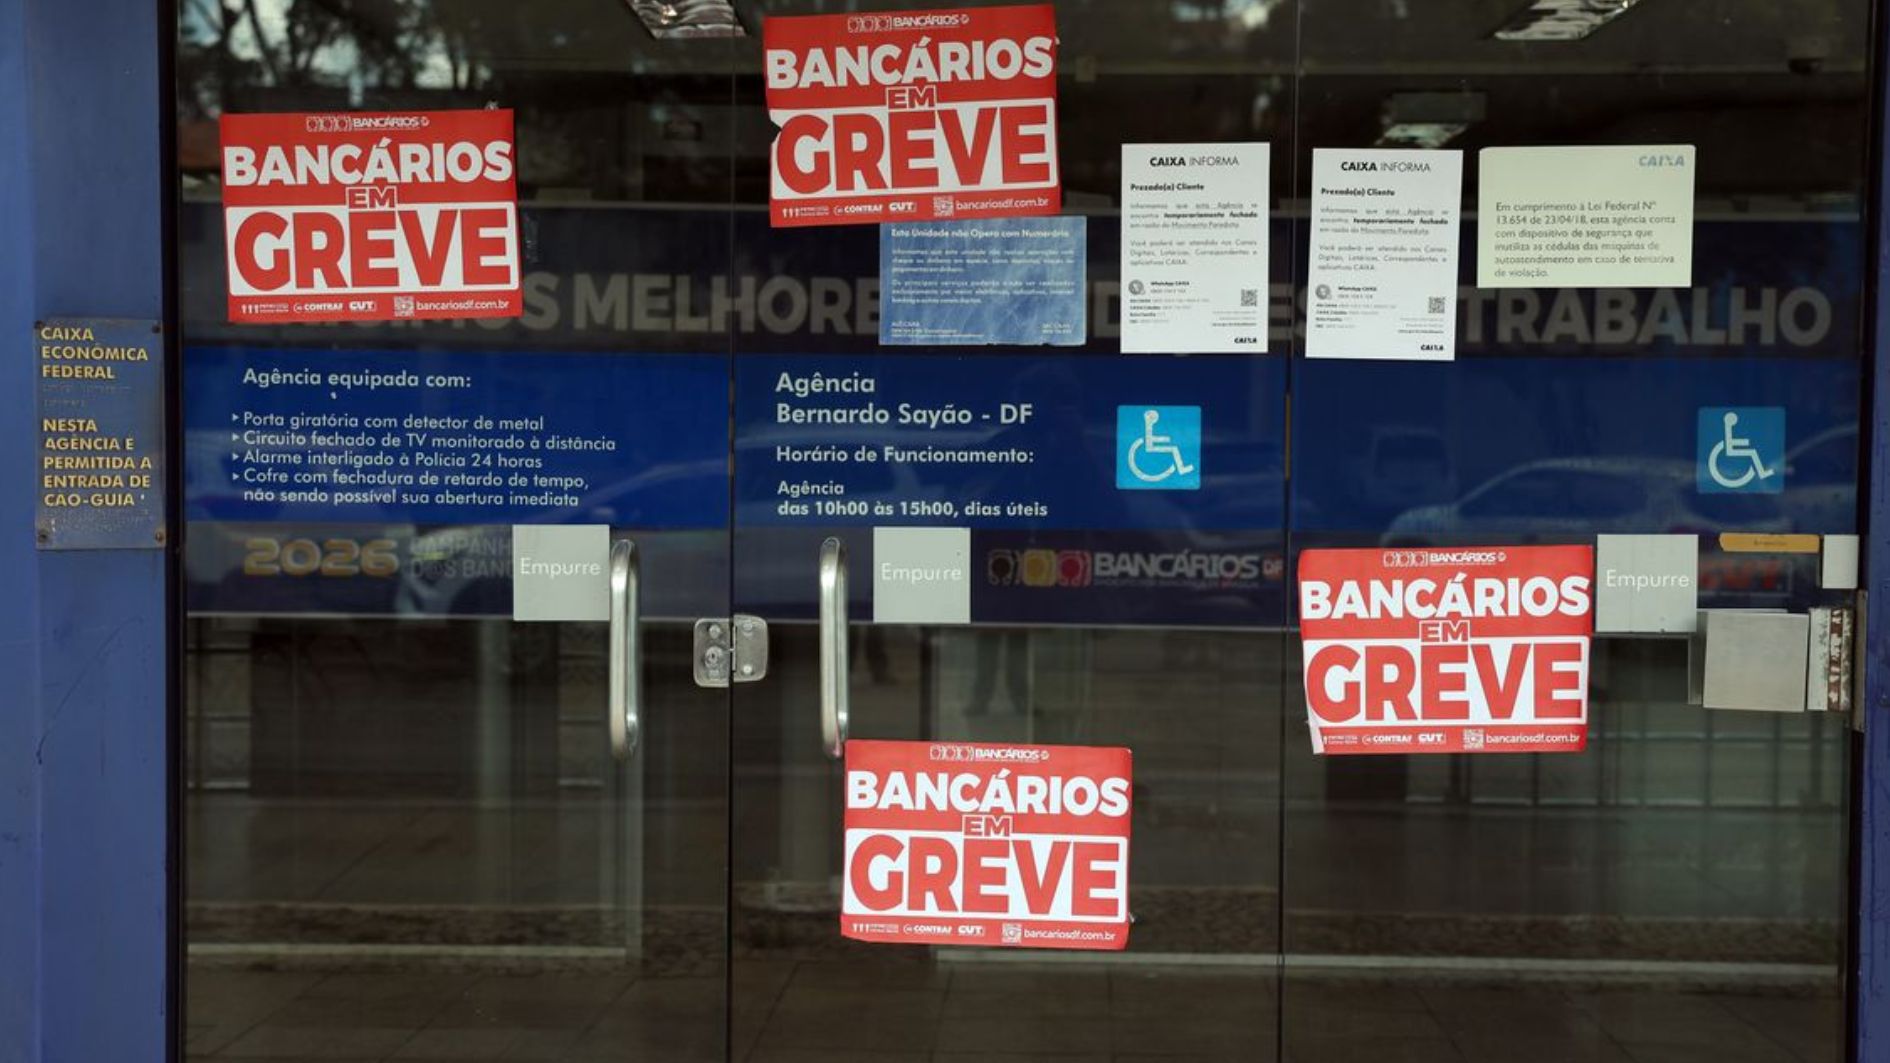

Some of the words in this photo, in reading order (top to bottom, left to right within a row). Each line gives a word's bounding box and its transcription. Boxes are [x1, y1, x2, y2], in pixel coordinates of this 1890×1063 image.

[892, 15, 959, 27] BANCÁRIOS
[767, 36, 1054, 88] BANCÁRIOS
[887, 86, 936, 109] EM
[353, 116, 419, 128] BANCÁRIOS
[776, 105, 1050, 194] GREVE
[224, 137, 512, 186] BANCÁRIOS
[1150, 157, 1186, 167] CAIXA
[1189, 157, 1239, 166] INFORMA
[1341, 162, 1377, 172] CAIXA
[1380, 162, 1431, 172] INFORMA
[1638, 155, 1685, 167] CAIXA
[1177, 183, 1204, 191] Cliente
[1367, 188, 1395, 196] Cliente
[347, 187, 396, 208] EM
[956, 197, 1049, 210] bancariosdf.com.br
[889, 203, 914, 212] CUT
[1496, 202, 1511, 211] Em
[1513, 203, 1577, 214] cumprimento
[1588, 202, 1601, 211] Lei
[1605, 201, 1640, 211] Federal
[1497, 215, 1527, 225] 13.654
[1529, 215, 1542, 225] de
[1590, 216, 1609, 224] esta
[1649, 216, 1676, 224] conta
[1495, 230, 1516, 238] com
[1519, 228, 1568, 240] dispositivo
[1572, 228, 1583, 238] de
[1586, 229, 1632, 240] segurança
[1635, 230, 1653, 240] que
[234, 209, 511, 291] GREVE
[1533, 243, 1543, 251] as
[1583, 241, 1598, 251] das
[1648, 241, 1659, 250] de
[1495, 255, 1574, 265] autoatendimento
[1595, 256, 1616, 264] caso
[1619, 255, 1631, 264] de
[1634, 255, 1675, 264] tentativa
[1495, 268, 1506, 277] de
[349, 301, 373, 311] CUT
[416, 299, 509, 310] bancariosdf.com.br
[1457, 286, 1831, 347] TRABALHO
[41, 328, 94, 340] CAIXA
[42, 365, 115, 379] FEDERAL
[243, 368, 321, 388] Agência
[328, 369, 419, 390] equipada
[426, 375, 471, 388] com:
[775, 371, 876, 397] Agência
[244, 411, 284, 426] Porta
[290, 412, 358, 430] giratória
[363, 416, 398, 428] com
[403, 414, 468, 429] detector
[473, 415, 493, 430] de
[499, 416, 544, 431] metal
[777, 403, 890, 424] Bernardo
[898, 403, 973, 429] Sayão
[1000, 404, 1033, 424] DF
[43, 419, 97, 432] NESTA
[243, 430, 306, 446] Circuito
[311, 431, 376, 447] fechado
[381, 432, 401, 447] de
[406, 433, 427, 447] TV
[432, 434, 525, 450] monitorado
[530, 435, 540, 450] à
[545, 435, 616, 451] distância
[44, 456, 135, 470] PERMITIDA
[140, 457, 152, 470] A
[243, 449, 302, 464] Alarme
[307, 450, 394, 468] interligado
[399, 452, 409, 466] à
[416, 452, 466, 466] Polícia
[471, 453, 492, 467] 24
[498, 454, 543, 468] horas
[776, 446, 848, 462] Horário
[854, 446, 877, 462] de
[884, 446, 1034, 463] Funcionamento:
[44, 475, 124, 488] ENTRADA
[130, 475, 151, 488] DE
[244, 467, 289, 483] Cofre
[293, 472, 327, 484] com
[332, 468, 413, 485] fechadura
[419, 470, 438, 485] de
[444, 471, 503, 487] retardo
[508, 472, 528, 487] de
[533, 474, 589, 491] tempo,
[244, 488, 275, 501] não
[280, 488, 328, 502] sendo
[333, 489, 396, 506] possível
[402, 492, 429, 504] sua
[434, 490, 503, 505] abertura
[509, 491, 579, 507] imediata
[777, 480, 844, 498] Agência
[778, 501, 809, 516] das
[815, 501, 868, 516] 10h00
[874, 501, 894, 516] às
[900, 501, 959, 519] 15h00,
[964, 501, 1001, 516] dias
[1007, 501, 1048, 517] úteis
[243, 538, 399, 577] 2026
[1093, 548, 1259, 579] BANCÁRIOS
[1430, 552, 1496, 563] BANCÁRIOS
[520, 557, 600, 579] Empurre
[881, 561, 962, 584] Empurre
[1606, 569, 1689, 592] Empurre
[1301, 572, 1590, 619] BANCÁRIOS
[1420, 620, 1470, 642] EM
[1306, 642, 1582, 723] GREVE
[1418, 733, 1443, 743] CUT
[1486, 733, 1580, 745] bancariosdf.com.br
[975, 748, 1039, 760] BANCÁRIOS
[848, 769, 1129, 817] BANCÁRIOS
[963, 815, 1012, 837] EM
[850, 834, 1119, 917] GREVE
[957, 925, 982, 935] CUT
[1024, 928, 1115, 942] bancariosdf.com.br
